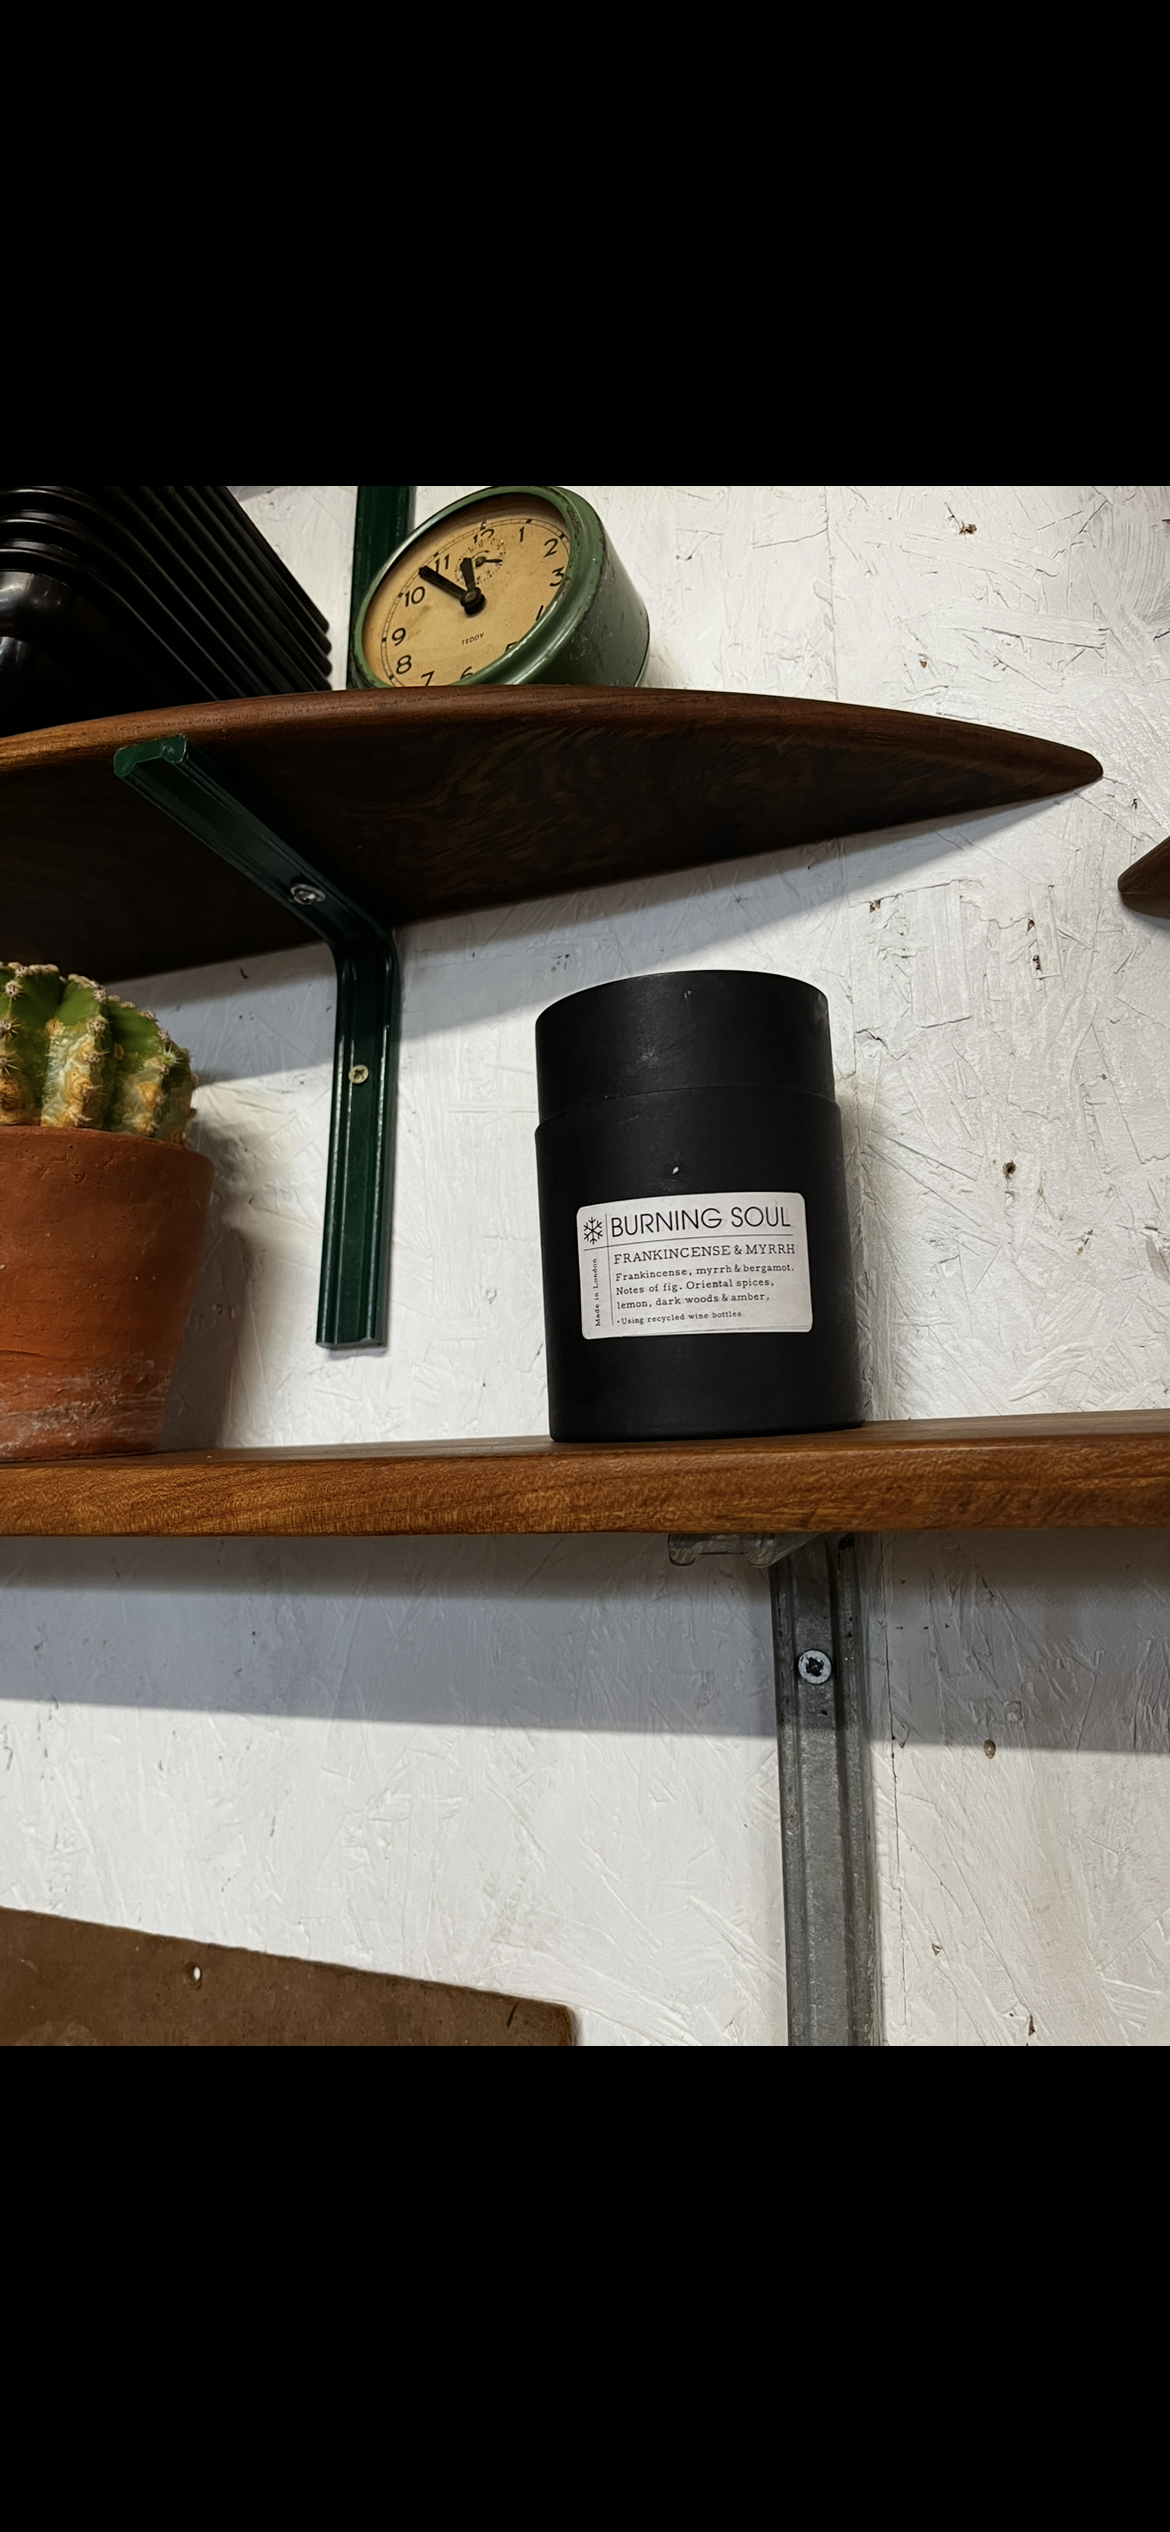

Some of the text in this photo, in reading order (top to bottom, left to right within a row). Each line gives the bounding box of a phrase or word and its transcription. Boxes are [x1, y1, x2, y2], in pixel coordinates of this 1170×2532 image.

[519, 526, 525, 543] 1
[543, 537, 559, 558] 2
[434, 553, 450, 573] 11
[549, 566, 565, 587] 3
[404, 586, 425, 607] 10
[391, 627, 407, 646] 9
[461, 632, 485, 646] TEDDY
[396, 654, 412, 674] 8
[421, 670, 435, 686] 7
[611, 1206, 791, 1238] BURNING SOUL
[614, 1243, 796, 1265] FRANKINCENSE & MYRRH
[615, 1264, 795, 1282] Frankincense, myrrh & bergamot.
[616, 1278, 774, 1296] Notes of fig. Oriental spices,
[594, 1292, 599, 1301] in
[617, 1300, 652, 1310] lemon,
[655, 1296, 681, 1306] dark
[685, 1294, 719, 1304] woods
[721, 1293, 728, 1302] &
[621, 1310, 742, 1325] Using recycled wine bottles
